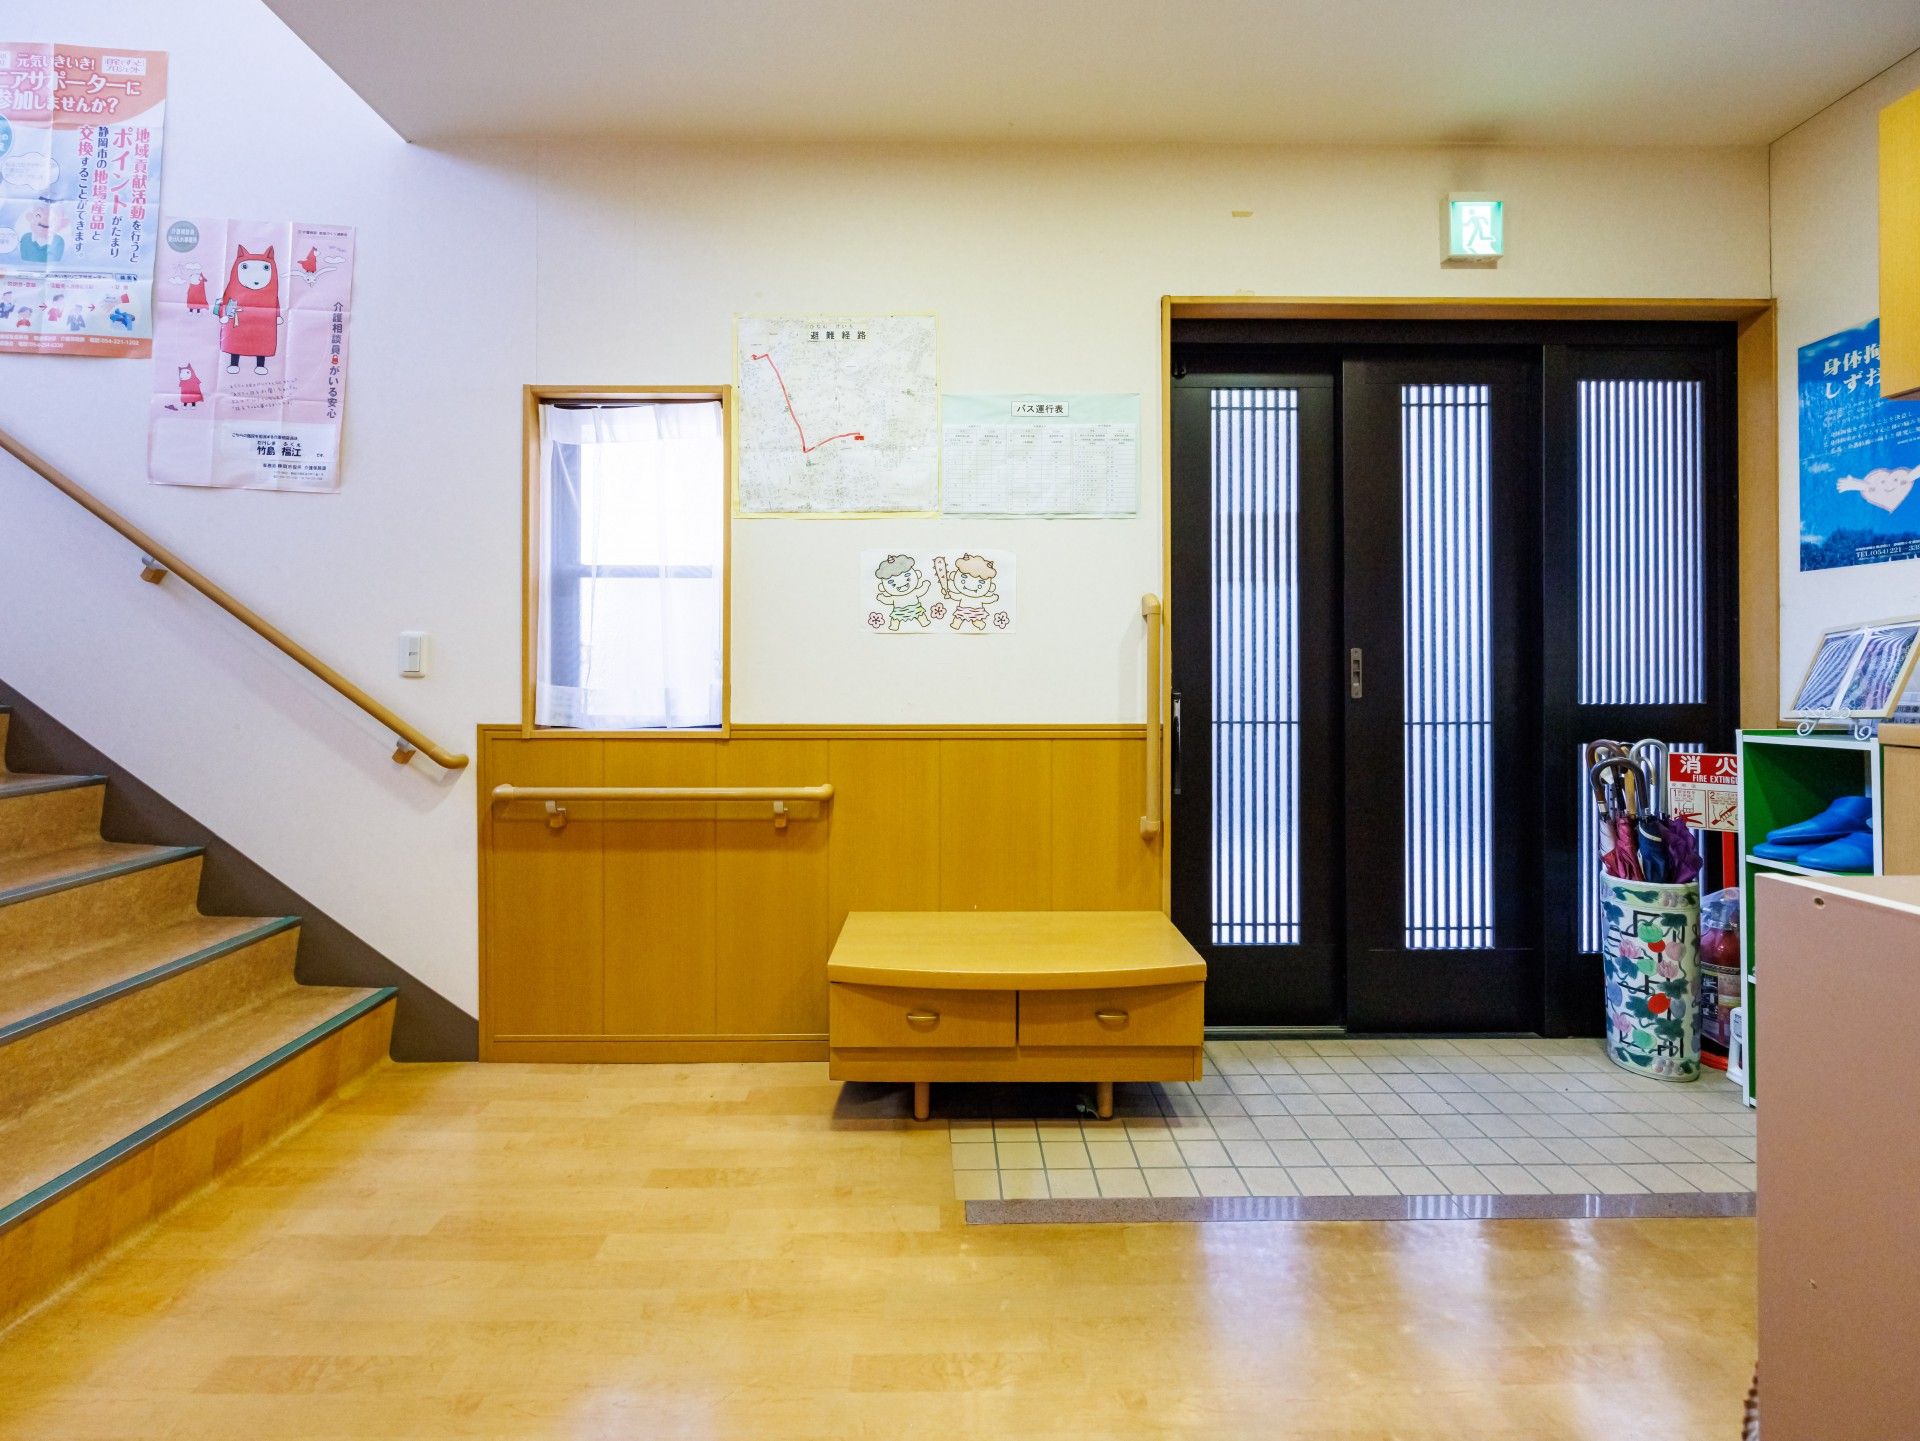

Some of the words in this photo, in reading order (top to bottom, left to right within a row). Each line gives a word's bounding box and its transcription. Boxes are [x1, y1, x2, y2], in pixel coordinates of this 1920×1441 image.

[90, 126, 110, 241] 静岡市の地場産品と
[109, 126, 133, 258] ポイントがたまり
[129, 127, 150, 263] 地域貢献活動を行うと
[810, 331, 867, 340] 避難経路
[1016, 404, 1064, 414] バス運行表
[256, 446, 276, 456] 竹島
[281, 447, 302, 457] 福江
[1692, 774, 1708, 783] FIRE
